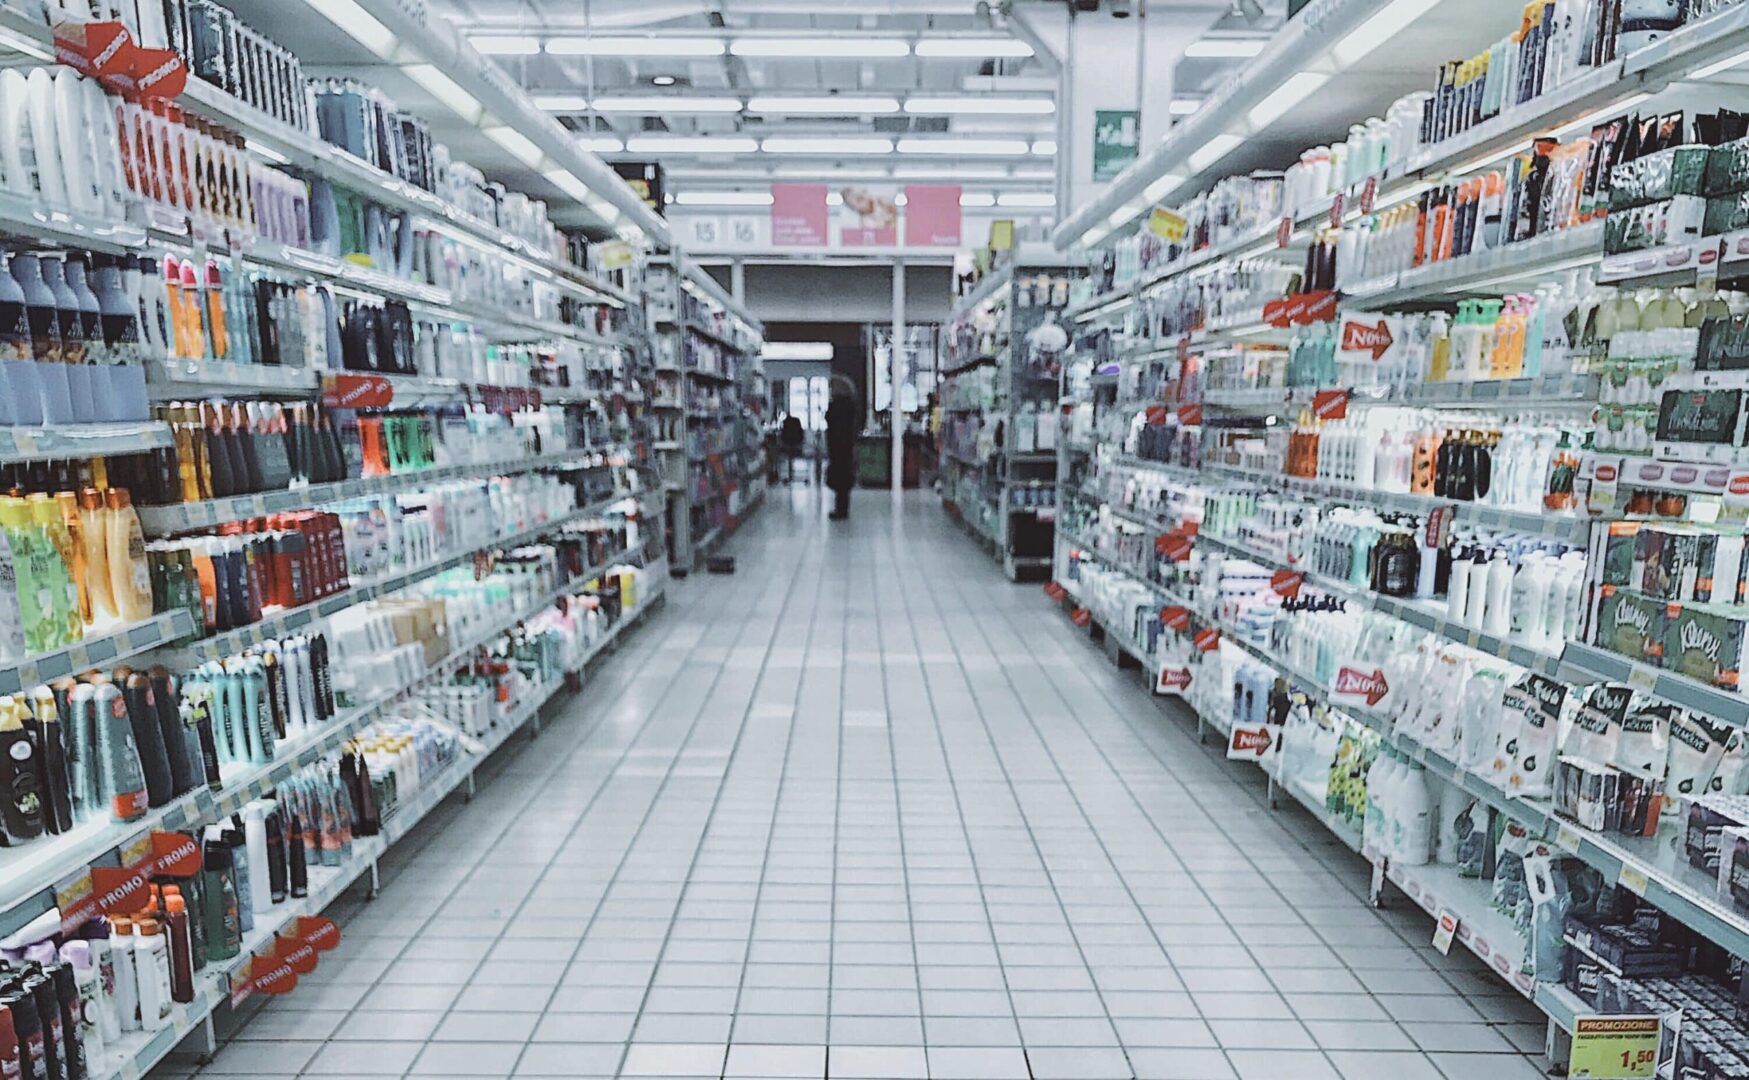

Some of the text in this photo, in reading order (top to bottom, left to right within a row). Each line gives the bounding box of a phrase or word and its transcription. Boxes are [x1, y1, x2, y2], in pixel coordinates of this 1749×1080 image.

[92, 29, 129, 70] PROMO
[137, 57, 180, 91] PROMO
[157, 840, 196, 870] PROMO
[98, 875, 143, 909] PROMO
[284, 944, 313, 965] ROMO
[255, 964, 293, 990] PROMO
[1580, 1021, 1655, 1031] PROMOZIONE
[1620, 1049, 1655, 1071] 1,50
